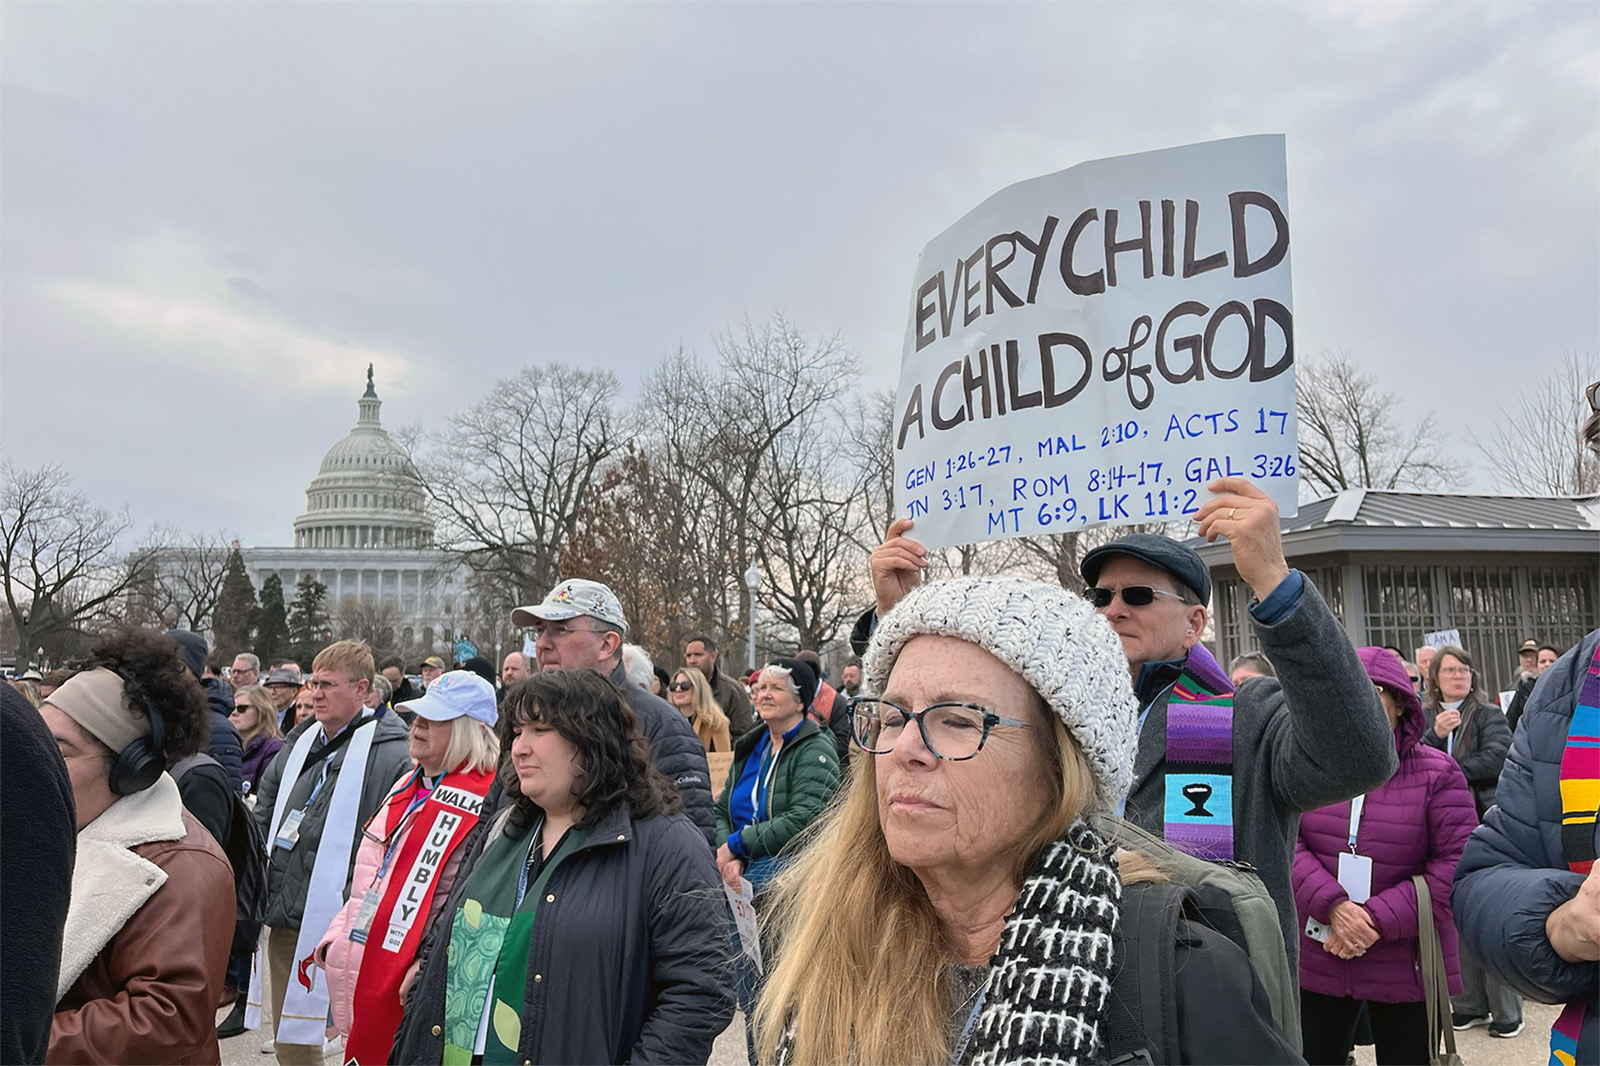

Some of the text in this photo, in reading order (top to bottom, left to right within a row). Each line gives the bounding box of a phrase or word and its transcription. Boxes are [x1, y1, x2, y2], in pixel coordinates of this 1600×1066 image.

[915, 191, 1290, 353] EVERY CHILD
[897, 299, 1294, 450] A CHILD of GOD
[905, 407, 1289, 491] GEN 1:26-27, MAL 2:10, ACTS 17
[906, 496, 929, 521] JN
[943, 484, 994, 511] 3:17,
[1012, 475, 1070, 500] ROM
[1185, 456, 1244, 483] GAL
[1251, 454, 1296, 479] 3:26
[987, 489, 1200, 535] MT 6:9, LK 11:2
[434, 788, 483, 815] WALK
[401, 814, 457, 922] HUMBLY
[388, 939, 401, 947] GOD
[389, 929, 405, 938] WITH
